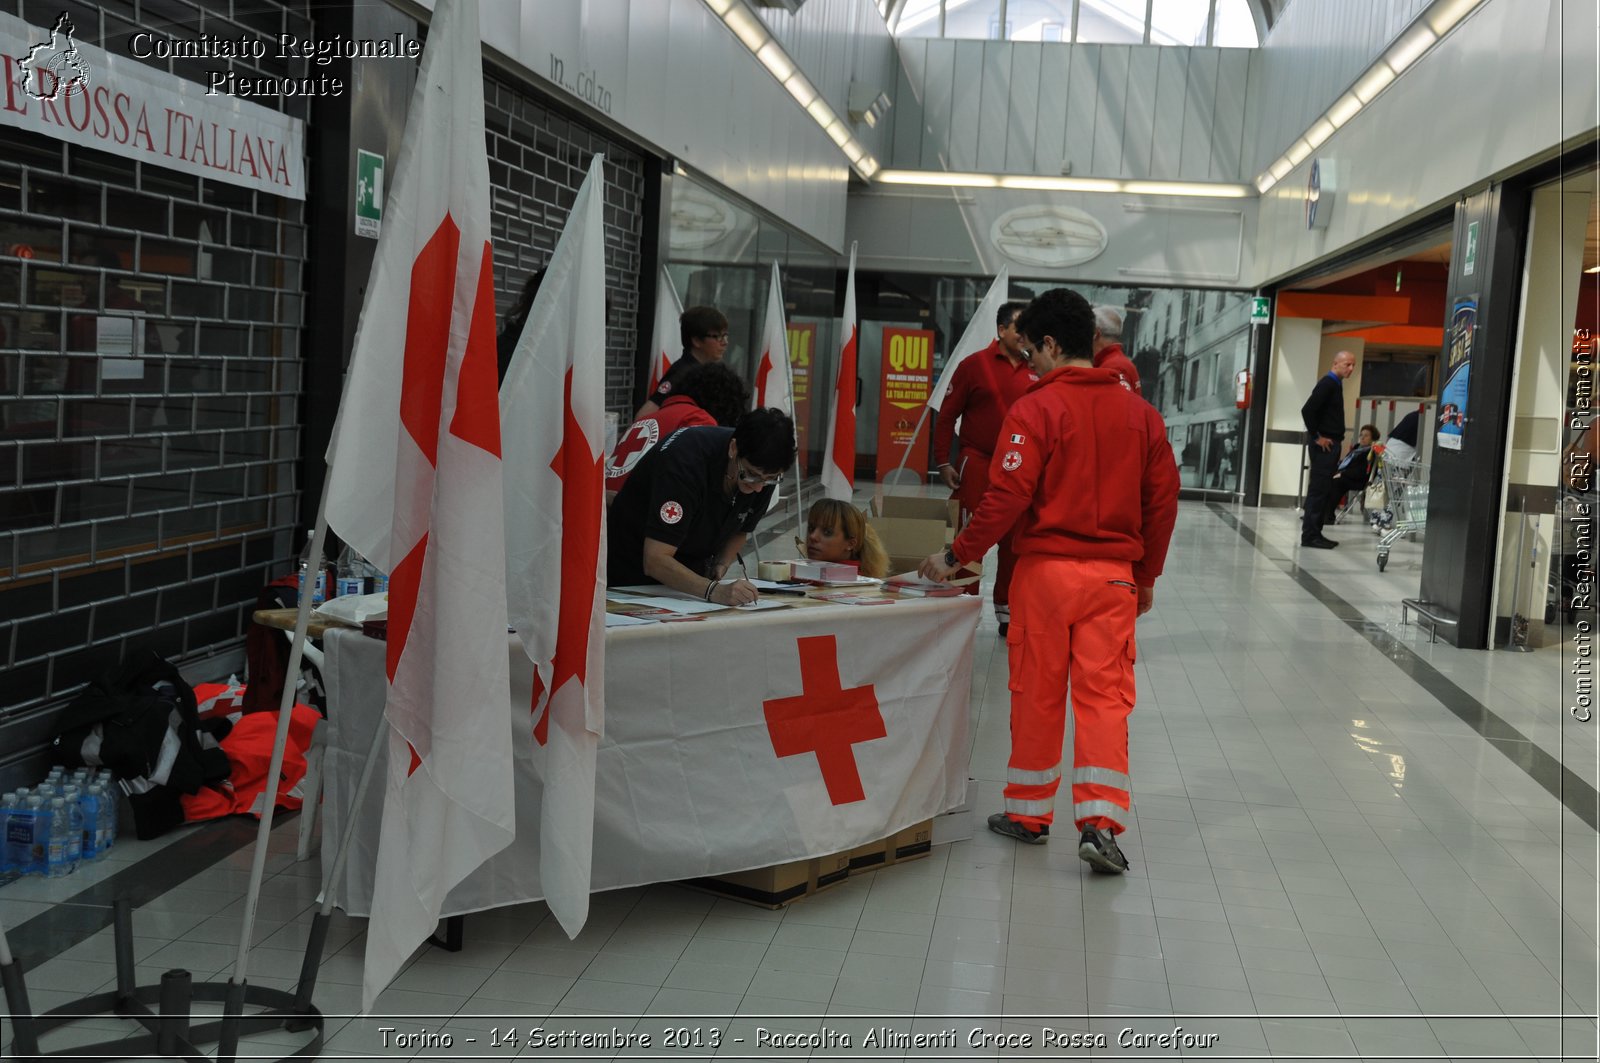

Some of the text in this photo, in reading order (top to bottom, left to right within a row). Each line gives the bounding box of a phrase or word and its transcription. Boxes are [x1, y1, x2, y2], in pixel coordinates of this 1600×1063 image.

[37, 66, 155, 153] ROSSA
[165, 107, 292, 187] ITALIANA
[889, 334, 929, 372] QUI
